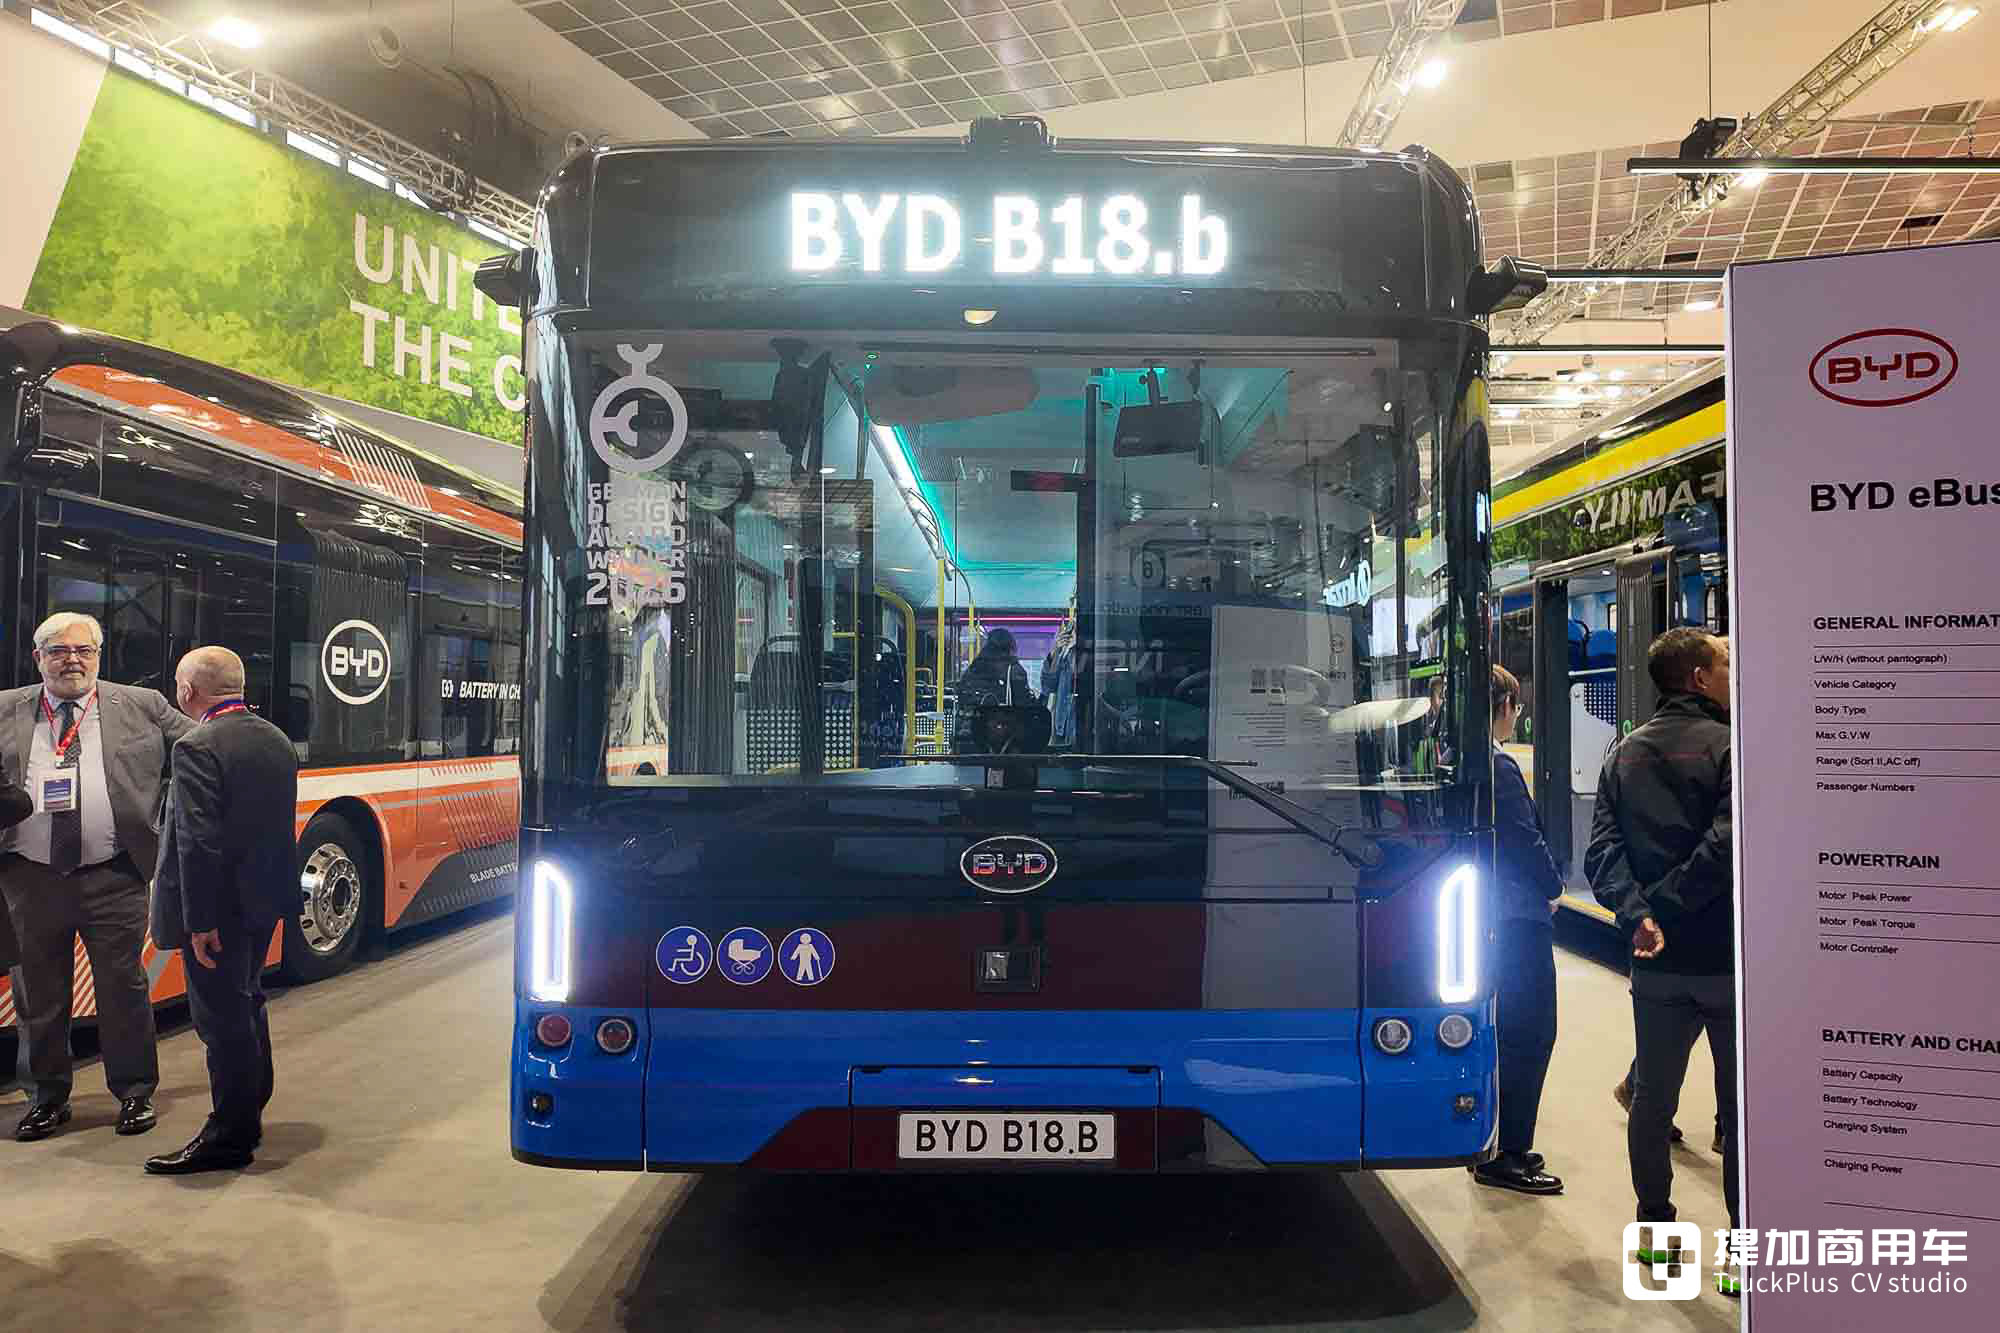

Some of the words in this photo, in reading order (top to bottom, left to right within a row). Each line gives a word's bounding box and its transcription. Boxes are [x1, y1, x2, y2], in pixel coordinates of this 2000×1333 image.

[791, 193, 961, 272] BYD
[993, 193, 1228, 275] B18.b
[351, 299, 473, 398] THE
[1828, 352, 1940, 384] BYD
[1811, 482, 1894, 511] BYD
[1814, 616, 1899, 630] GENERAL
[1905, 614, 2000, 629] INFORMAT
[331, 646, 384, 678] BYD
[1846, 655, 1884, 665] (without
[1887, 653, 1948, 665] pantograph)
[460, 681, 498, 699] BATTERY
[499, 684, 507, 699] IN
[508, 685, 520, 700] CH
[1814, 680, 1849, 689] Vehicle
[1852, 680, 1897, 690] Category
[1815, 705, 1839, 716] Body
[1844, 706, 1866, 716] Type
[1815, 731, 1836, 740] Max
[1816, 756, 1848, 767] Range
[1816, 782, 1868, 793] Passenger
[1871, 783, 1915, 792] Numbers
[973, 853, 1047, 874] BYD
[1818, 852, 1940, 869] POWERTRAIN
[470, 867, 496, 884] BLADE
[1818, 891, 1848, 900] Motor
[1852, 891, 1878, 902] Peak
[1880, 893, 1913, 902] Power
[1819, 917, 1848, 926] Motor
[1853, 917, 1878, 927] Peak
[1880, 919, 1916, 931] Torque
[1820, 942, 1848, 951] Motor
[1850, 943, 1899, 954] Controller
[1822, 1029, 1906, 1046] BATTERY
[1911, 1035, 1950, 1050] AND
[1823, 1067, 1857, 1080] Battery
[1859, 1071, 1903, 1084] Capacity
[1823, 1094, 1858, 1106] Battery
[1860, 1096, 1918, 1111] Technology
[1823, 1119, 1868, 1133] Charging
[1870, 1123, 1908, 1135] System
[916, 1119, 988, 1153] BYD
[1003, 1119, 1098, 1154] B18.B
[1824, 1158, 1869, 1172] Charging
[1871, 1163, 1903, 1174] Power
